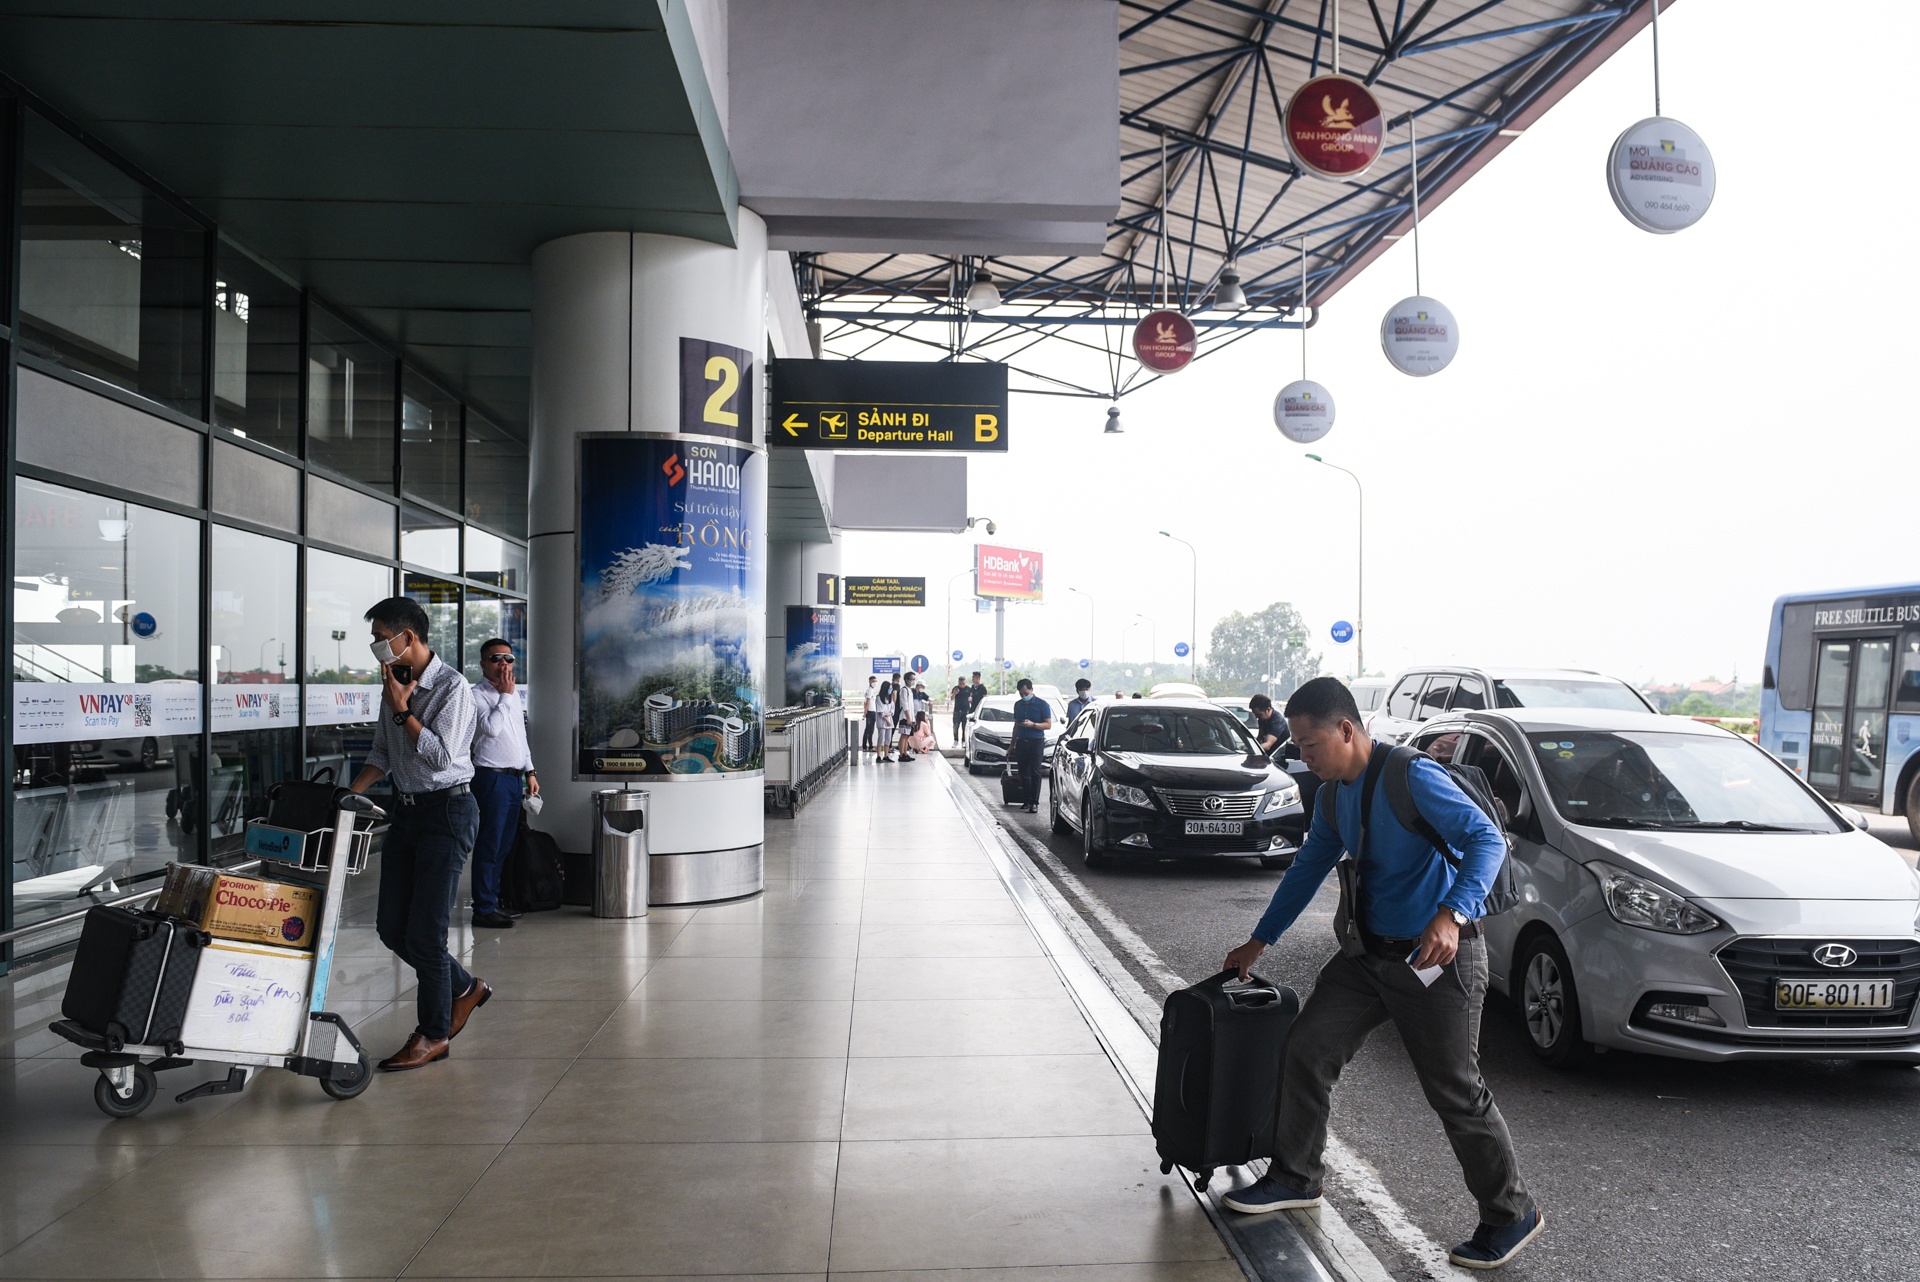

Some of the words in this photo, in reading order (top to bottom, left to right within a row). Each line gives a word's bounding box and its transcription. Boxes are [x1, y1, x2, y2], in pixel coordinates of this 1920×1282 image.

[1296, 131, 1315, 140] TAN
[1317, 132, 1352, 142] HOANG
[1353, 133, 1378, 144] MINH
[1321, 143, 1354, 152] GROUP
[1630, 173, 1674, 183] ADVERTISING
[1644, 200, 1659, 210] 090
[703, 356, 740, 428] 2
[857, 407, 907, 427] SẢNH
[912, 413, 929, 427] ĐI
[974, 414, 998, 442] B
[857, 429, 925, 443] Departure
[928, 430, 953, 442] Hall
[691, 446, 717, 460] SƠN
[674, 501, 694, 515] Sự
[677, 519, 752, 551] RỒNG
[983, 555, 1020, 573] HDBank
[826, 577, 835, 601] 1
[1814, 609, 1843, 626] FREE
[1844, 606, 1895, 624] SHUTTLE
[1896, 604, 1920, 621] BUS
[1332, 629, 1348, 638] VIB
[79, 694, 124, 714] VNPAY
[235, 693, 264, 709] VNPAY
[334, 692, 356, 706] VNPAY
[84, 715, 100, 727] Scan
[100, 715, 107, 726] to
[108, 716, 119, 728] Pay
[1815, 720, 1825, 732] XE
[1187, 822, 1241, 834] 30A-643.03
[229, 881, 256, 891] ORION
[270, 927, 276, 935] 2
[1779, 983, 1889, 1006] 30E-801.11
